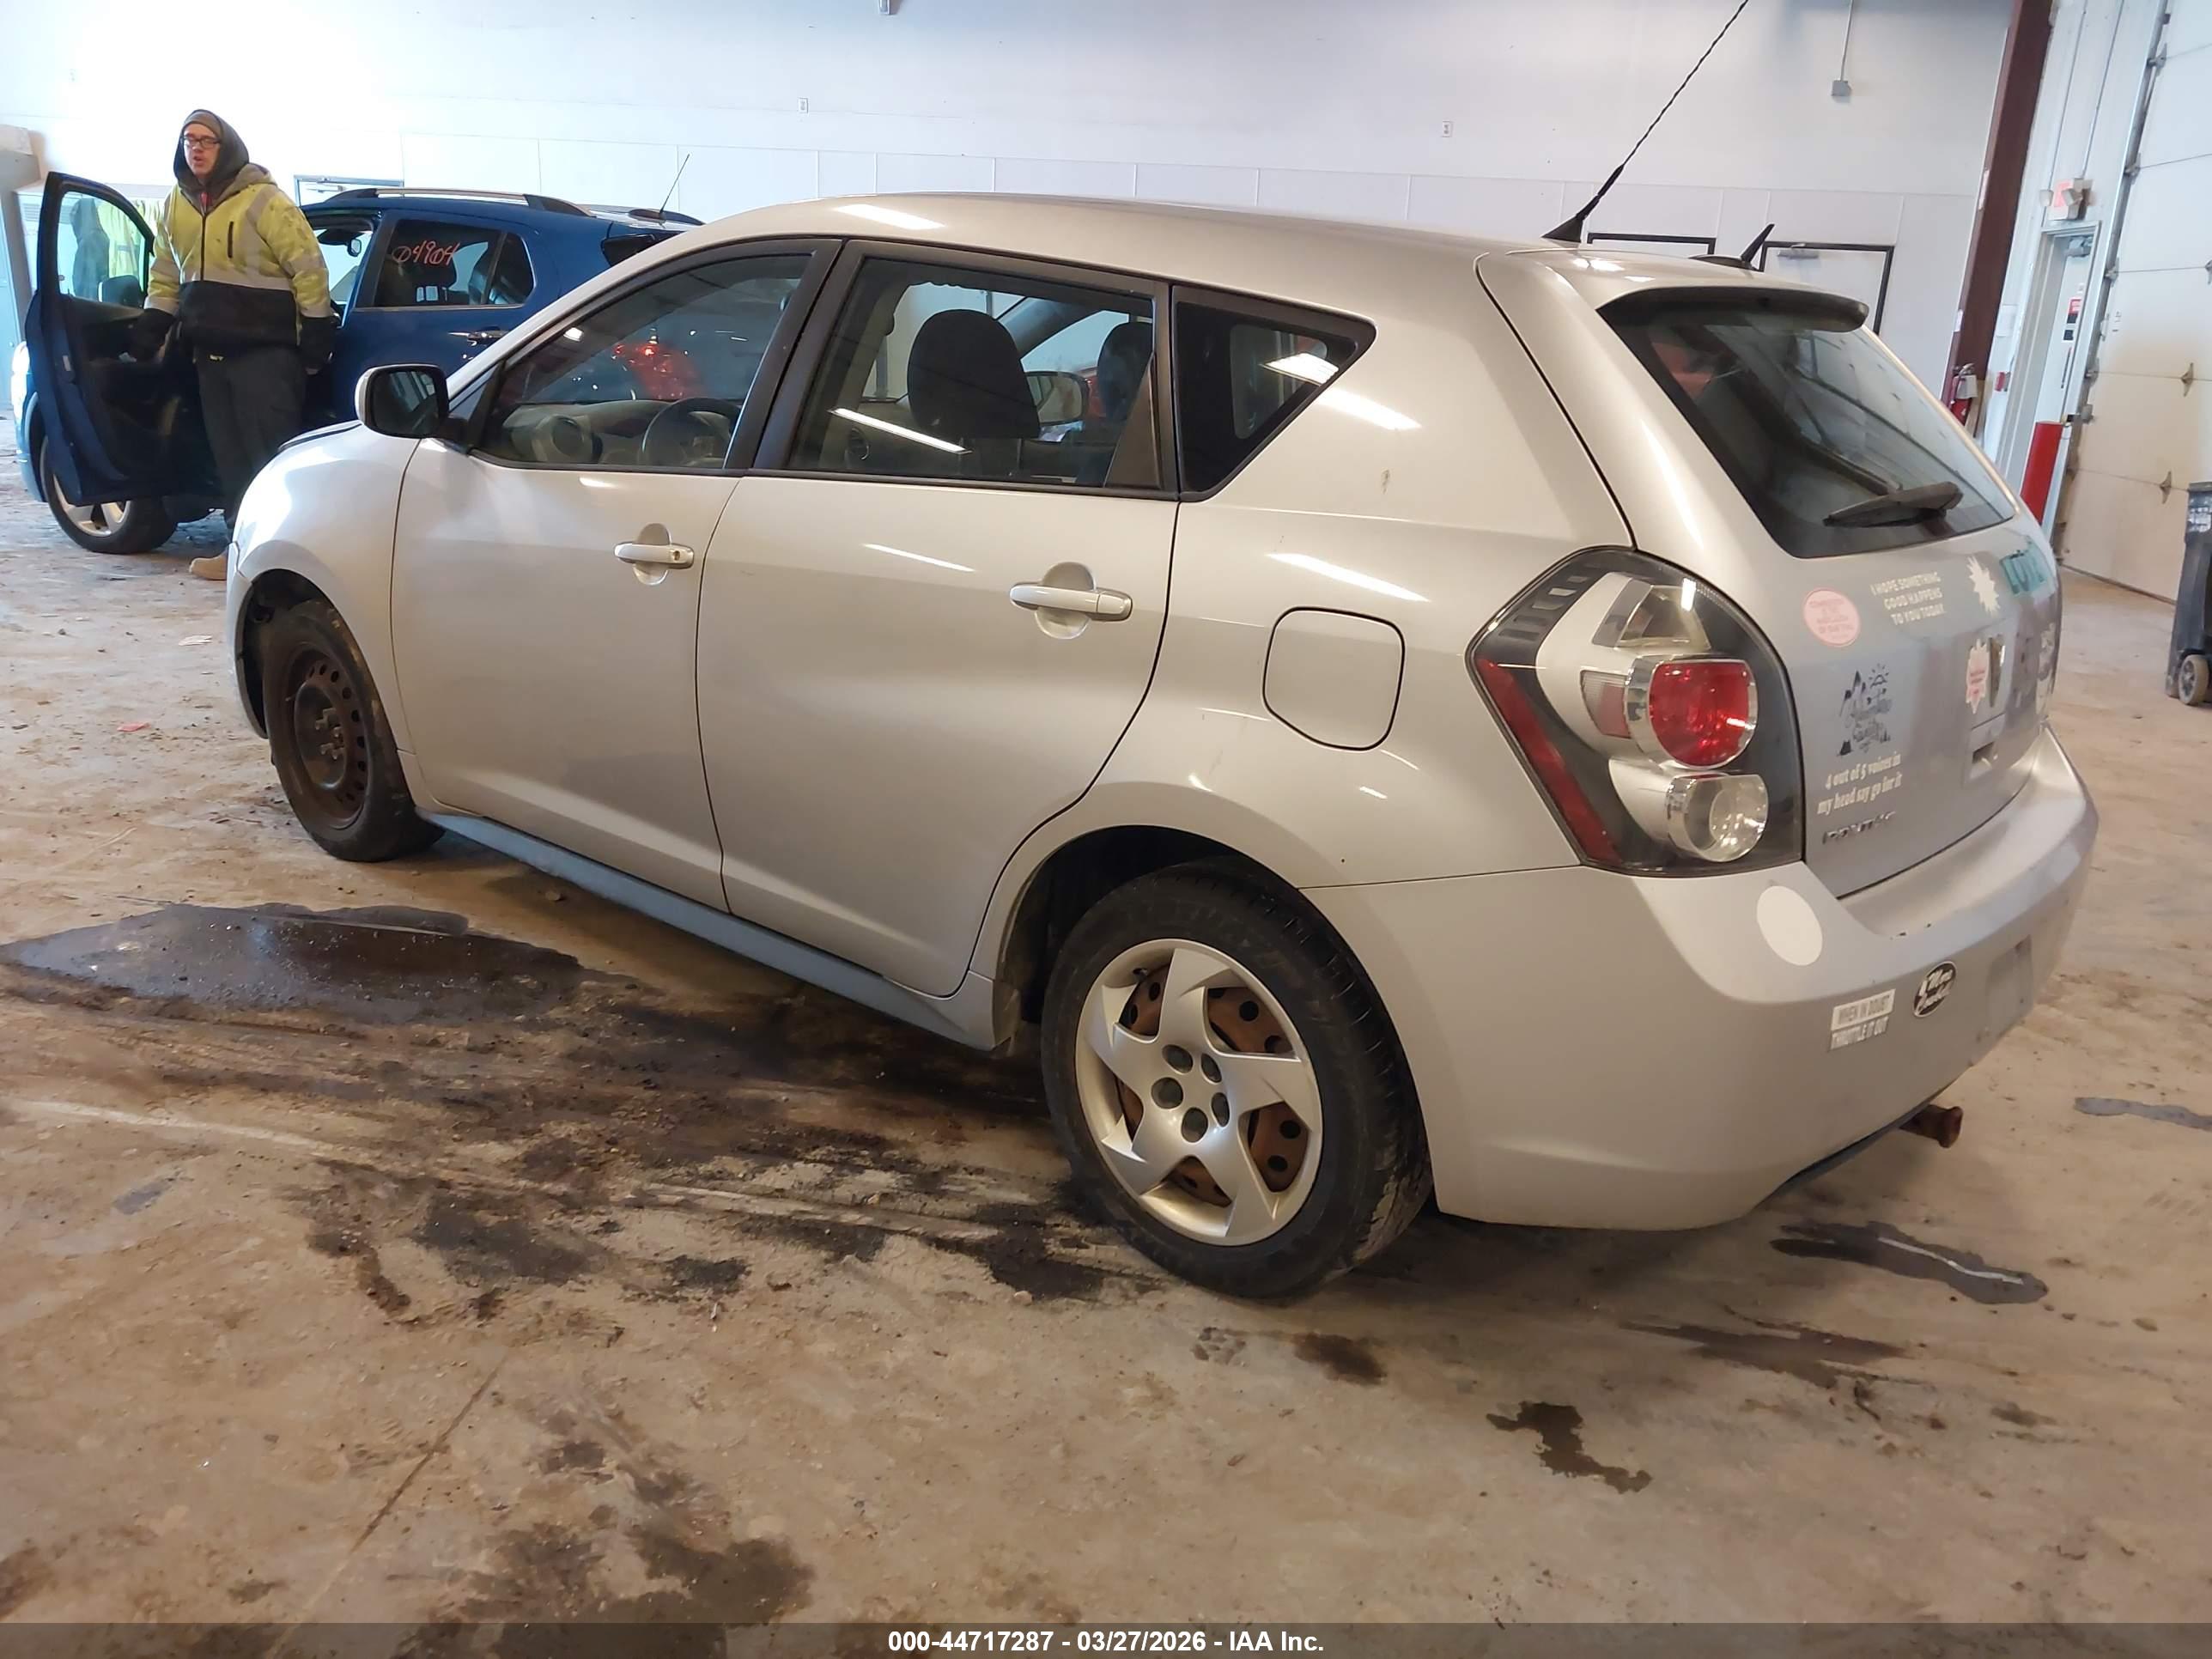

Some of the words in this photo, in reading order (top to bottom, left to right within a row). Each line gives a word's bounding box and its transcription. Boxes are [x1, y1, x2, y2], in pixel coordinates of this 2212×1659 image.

[1875, 579, 1899, 594] HOPE
[1884, 594, 1909, 611] GOOD
[1908, 587, 1943, 605] HAPPENS
[1890, 612, 1904, 626] TO
[1904, 609, 1921, 623] YOU
[1833, 769, 1850, 787] out
[1850, 763, 1861, 781] of
[1817, 798, 1834, 816] my
[1833, 786, 1856, 810] head
[1856, 786, 1870, 804] say
[1869, 782, 1882, 801] go
